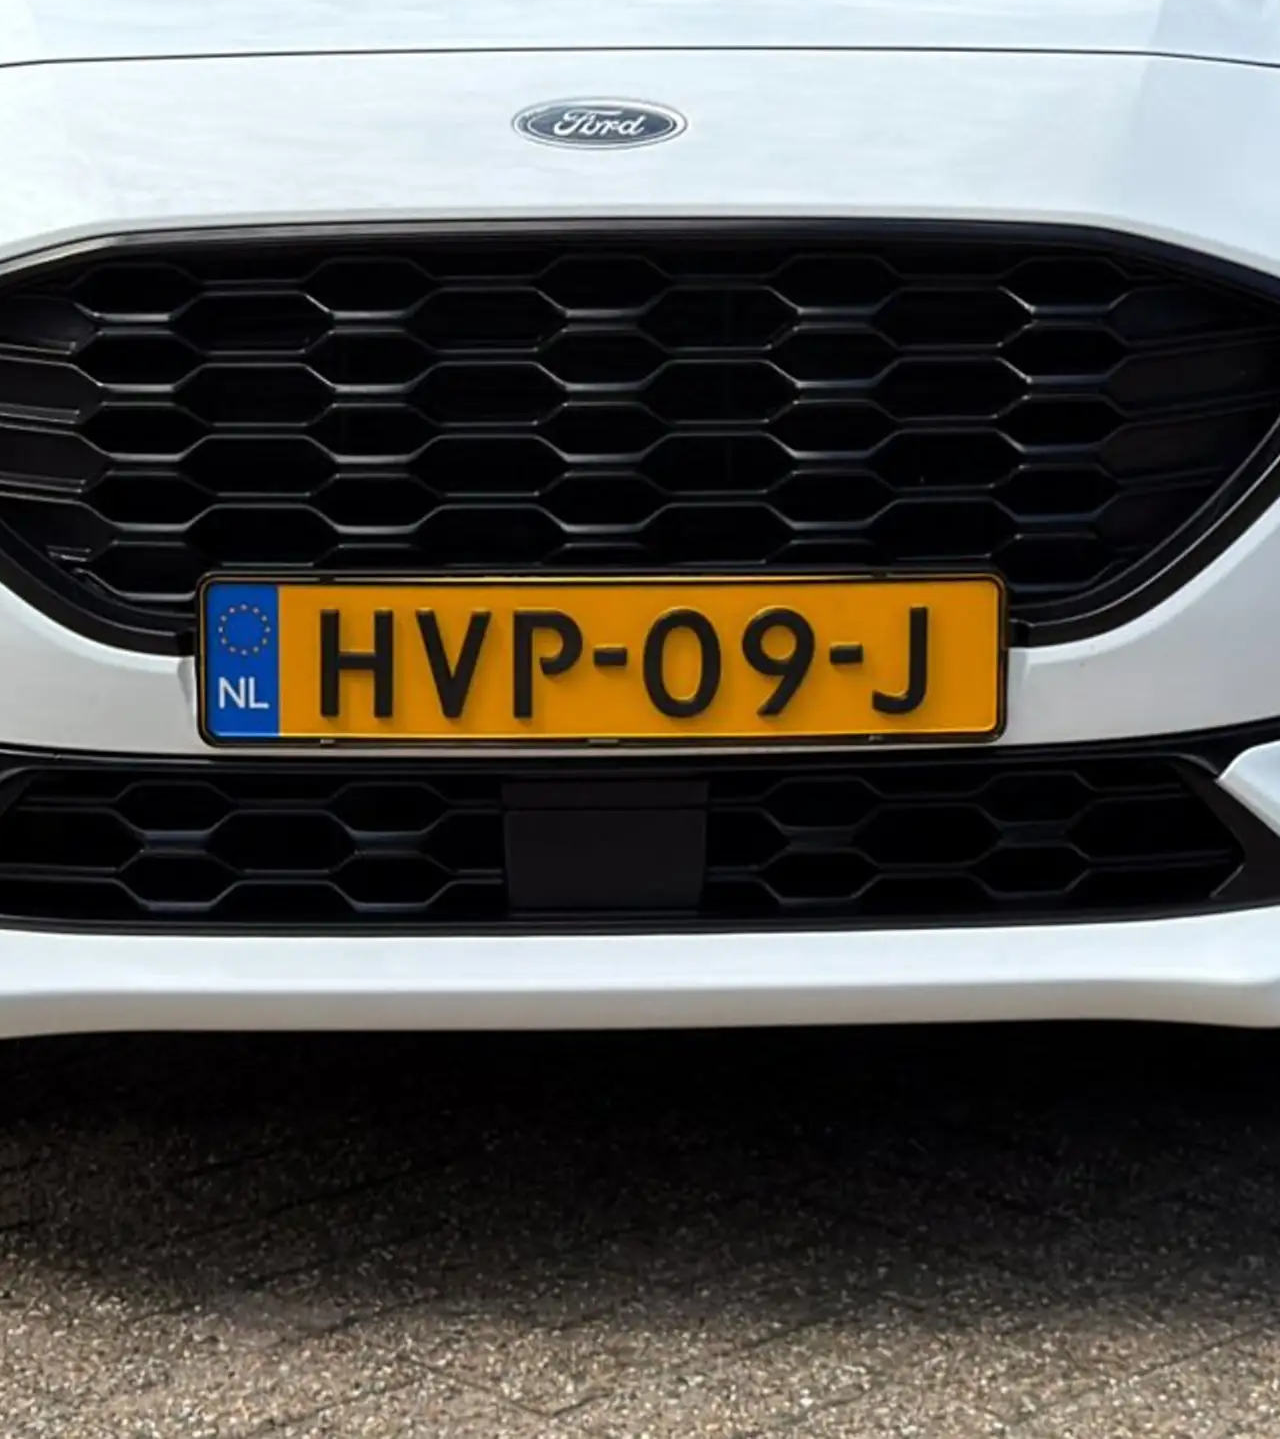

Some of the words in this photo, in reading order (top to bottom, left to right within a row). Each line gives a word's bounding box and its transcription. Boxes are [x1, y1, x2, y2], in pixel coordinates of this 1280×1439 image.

[553, 108, 647, 136] Ford
[217, 676, 270, 710] NL
[320, 606, 930, 719] HVP-09-J
